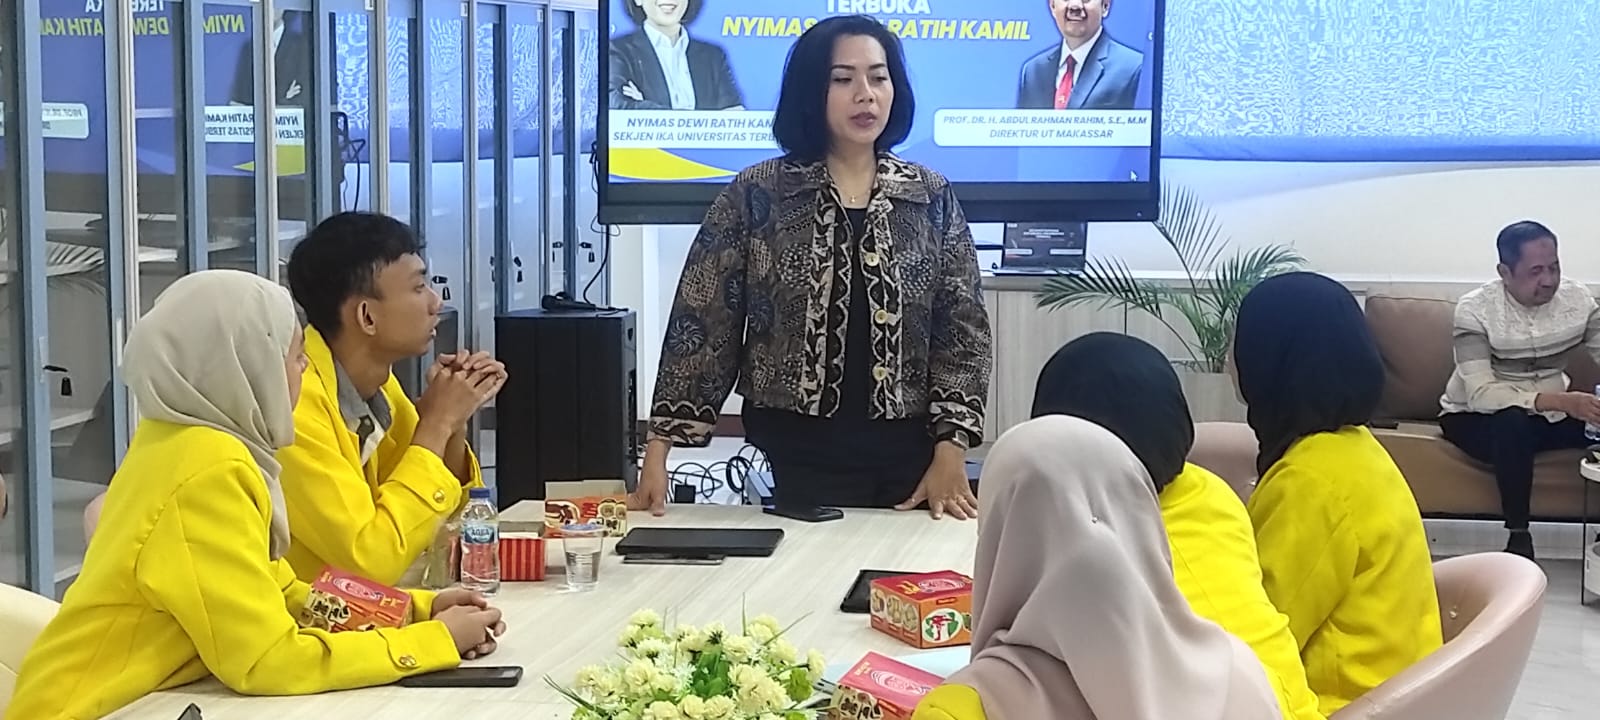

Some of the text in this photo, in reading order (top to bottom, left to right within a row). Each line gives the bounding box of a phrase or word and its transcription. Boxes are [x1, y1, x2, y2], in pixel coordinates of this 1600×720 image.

[826, 0, 932, 14] TERBUKA
[958, 20, 1031, 40] KAMIL
[627, 118, 675, 128] NYIMAS
[677, 118, 708, 128] DEWI
[711, 118, 746, 128] RATIH
[943, 115, 970, 124] PROF.
[971, 115, 986, 124] DR.
[999, 116, 1030, 124] ABDUL
[1031, 116, 1072, 124] RAHMAN
[1073, 116, 1106, 125] RAHIM,
[613, 131, 654, 141] SEKJEN
[655, 131, 674, 141] IKA
[677, 132, 747, 142] UNIVERSITAS
[989, 129, 1113, 139] DIREKTUR UT MAKASSAR
